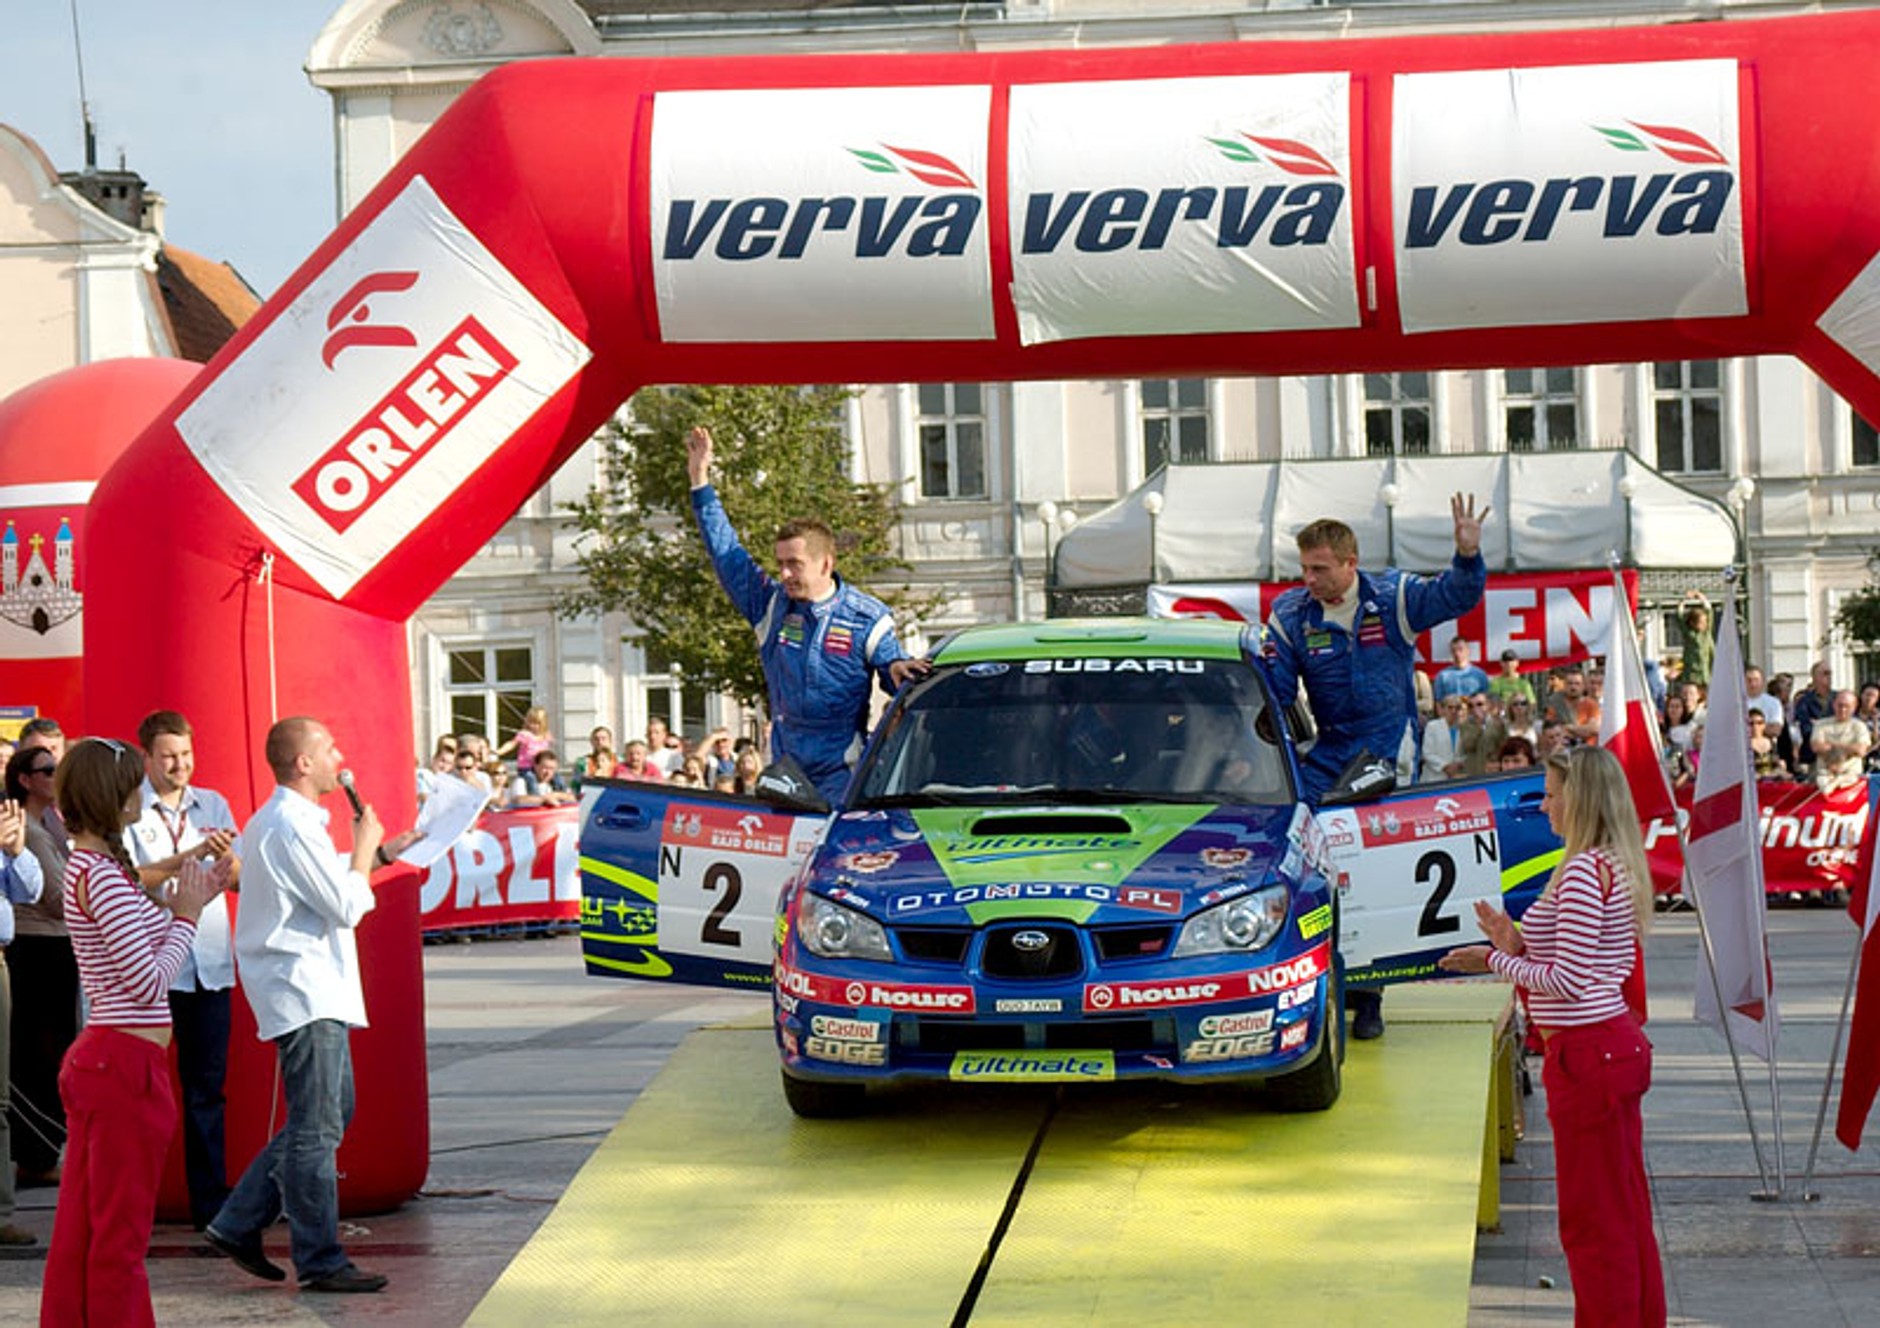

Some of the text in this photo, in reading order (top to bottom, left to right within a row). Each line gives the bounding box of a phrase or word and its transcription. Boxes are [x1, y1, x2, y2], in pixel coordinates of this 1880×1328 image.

[1021, 181, 1346, 255] verva
[1403, 169, 1734, 249] verva
[662, 194, 982, 260] verva
[315, 332, 502, 512] ORLEN
[1416, 585, 1615, 663] LEN
[1024, 659, 1205, 675] SUBARU
[1449, 816, 1489, 832] ORLEN
[660, 846, 681, 877] N
[1474, 831, 1498, 864] N
[420, 822, 581, 915] RLE
[701, 862, 742, 947] 2
[1414, 850, 1460, 938] 2
[871, 986, 968, 1008] house
[1119, 983, 1221, 1005] house
[826, 1020, 874, 1039] Castrol
[1218, 1013, 1269, 1034] Castrol
[805, 1036, 886, 1067] EDGE
[1186, 1031, 1277, 1063] EDGE
[961, 1056, 1104, 1076] ultimate
